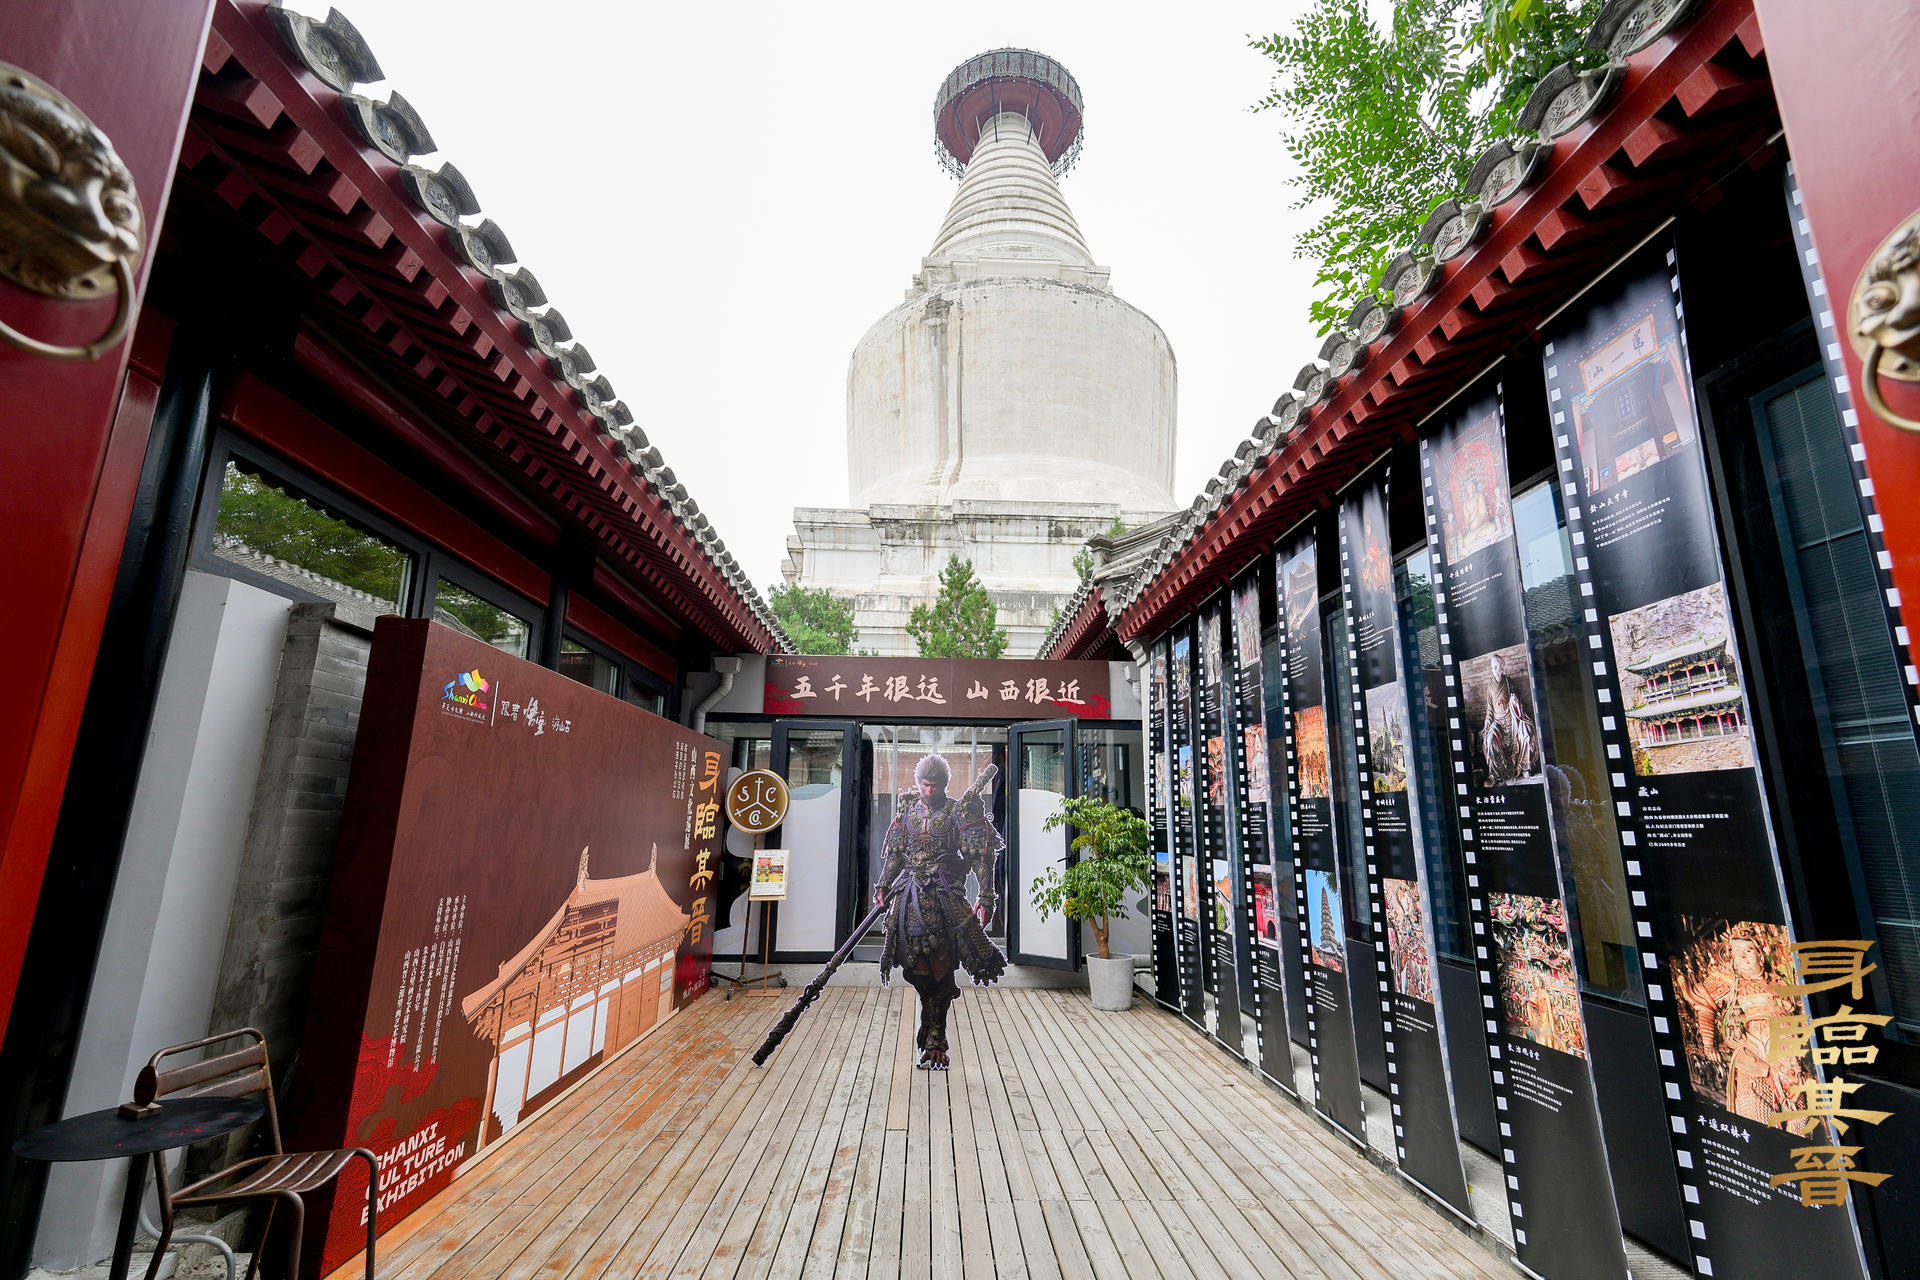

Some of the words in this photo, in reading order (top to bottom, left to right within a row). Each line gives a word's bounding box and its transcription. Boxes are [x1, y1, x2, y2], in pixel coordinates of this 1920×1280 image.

[790, 673, 946, 704] 五千年很远
[966, 677, 1086, 705] 山西很近
[737, 785, 750, 802] S
[765, 787, 777, 803] C
[1697, 1115, 1751, 1143] 平遥双林寺
[377, 1121, 439, 1173] SHANXI
[360, 1141, 466, 1227] EXHIBITION
